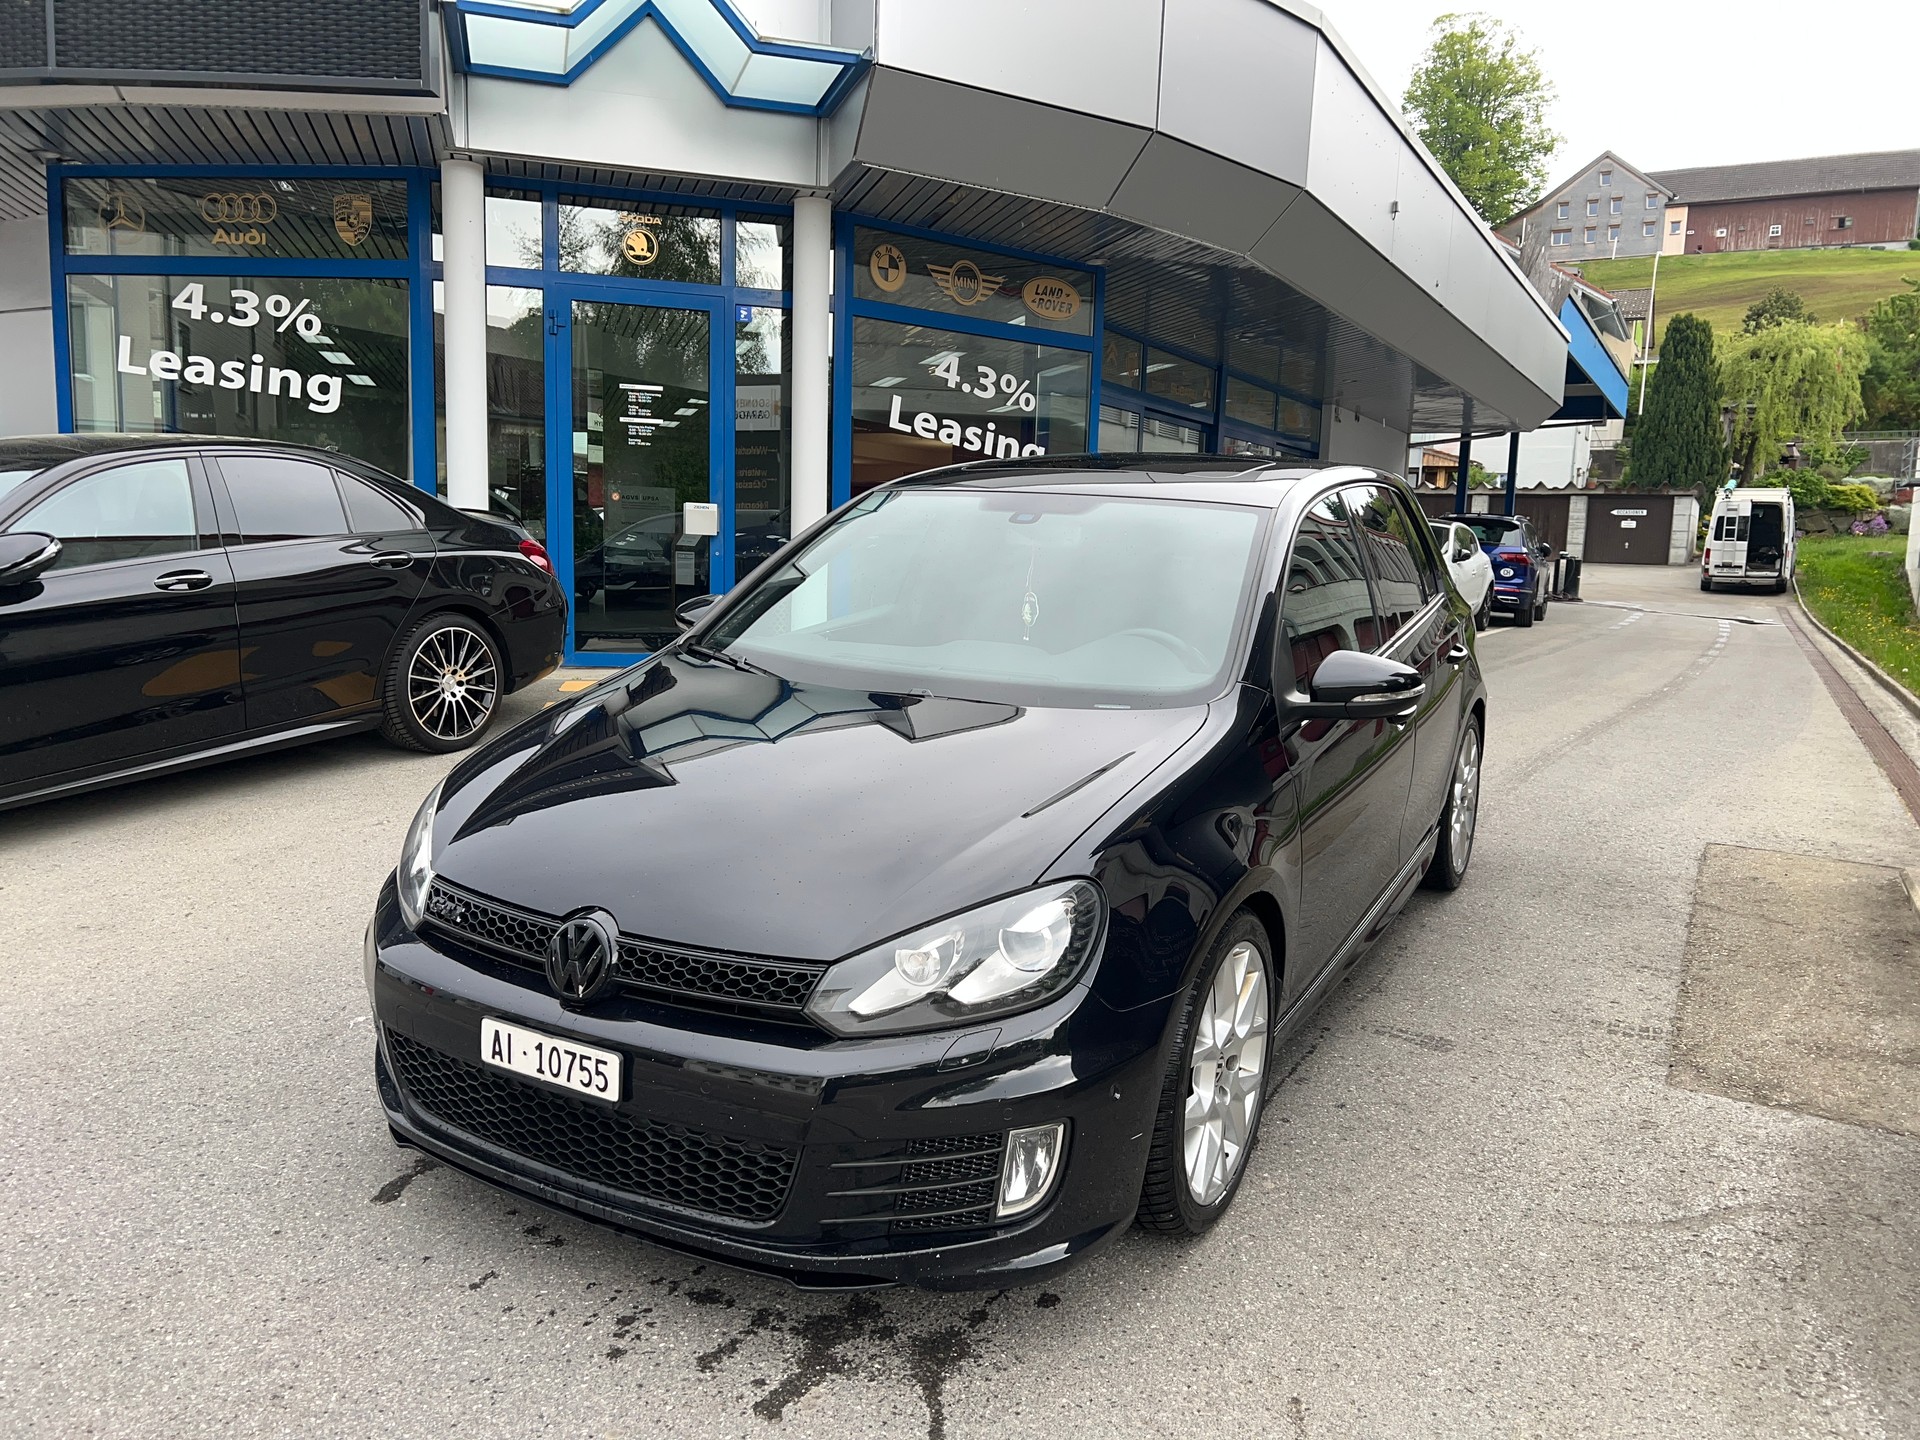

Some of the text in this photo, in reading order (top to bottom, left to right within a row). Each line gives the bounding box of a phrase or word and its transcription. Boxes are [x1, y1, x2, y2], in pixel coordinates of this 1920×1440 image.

[211, 228, 267, 246] Audi
[874, 245, 904, 264] BMW
[953, 275, 978, 291] MINI
[1034, 283, 1064, 299] LAND
[171, 282, 322, 337] 4.3%
[1036, 299, 1073, 315] ROVER
[117, 335, 343, 414] Leasing
[934, 355, 1036, 412] 4.3%
[491, 1029, 609, 1093] AI 10755
